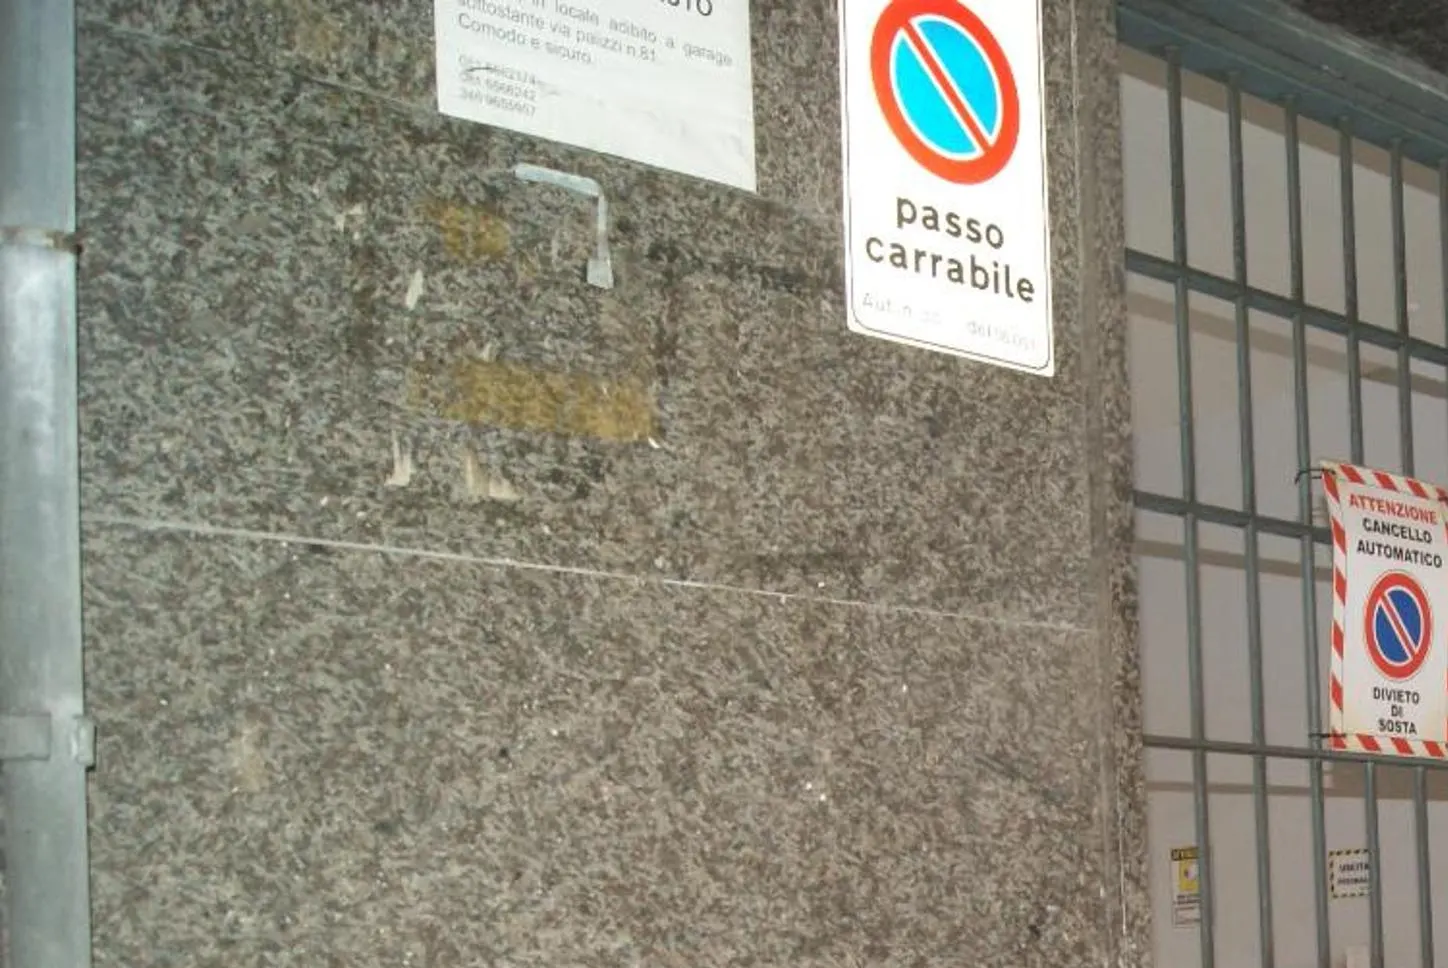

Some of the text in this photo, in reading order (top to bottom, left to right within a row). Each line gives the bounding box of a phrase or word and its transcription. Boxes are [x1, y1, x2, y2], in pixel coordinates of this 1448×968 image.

[458, 12, 527, 45] Comodo
[896, 197, 1005, 249] passo
[865, 236, 1035, 303] carrabile
[1349, 493, 1438, 526] ATTENZIONE
[1362, 516, 1433, 544] CANCELLO
[1356, 539, 1443, 569] AUTOMATICO
[1372, 686, 1420, 705] DIVIETO
[1390, 704, 1403, 718] DI
[1378, 718, 1418, 736] SOSTA
